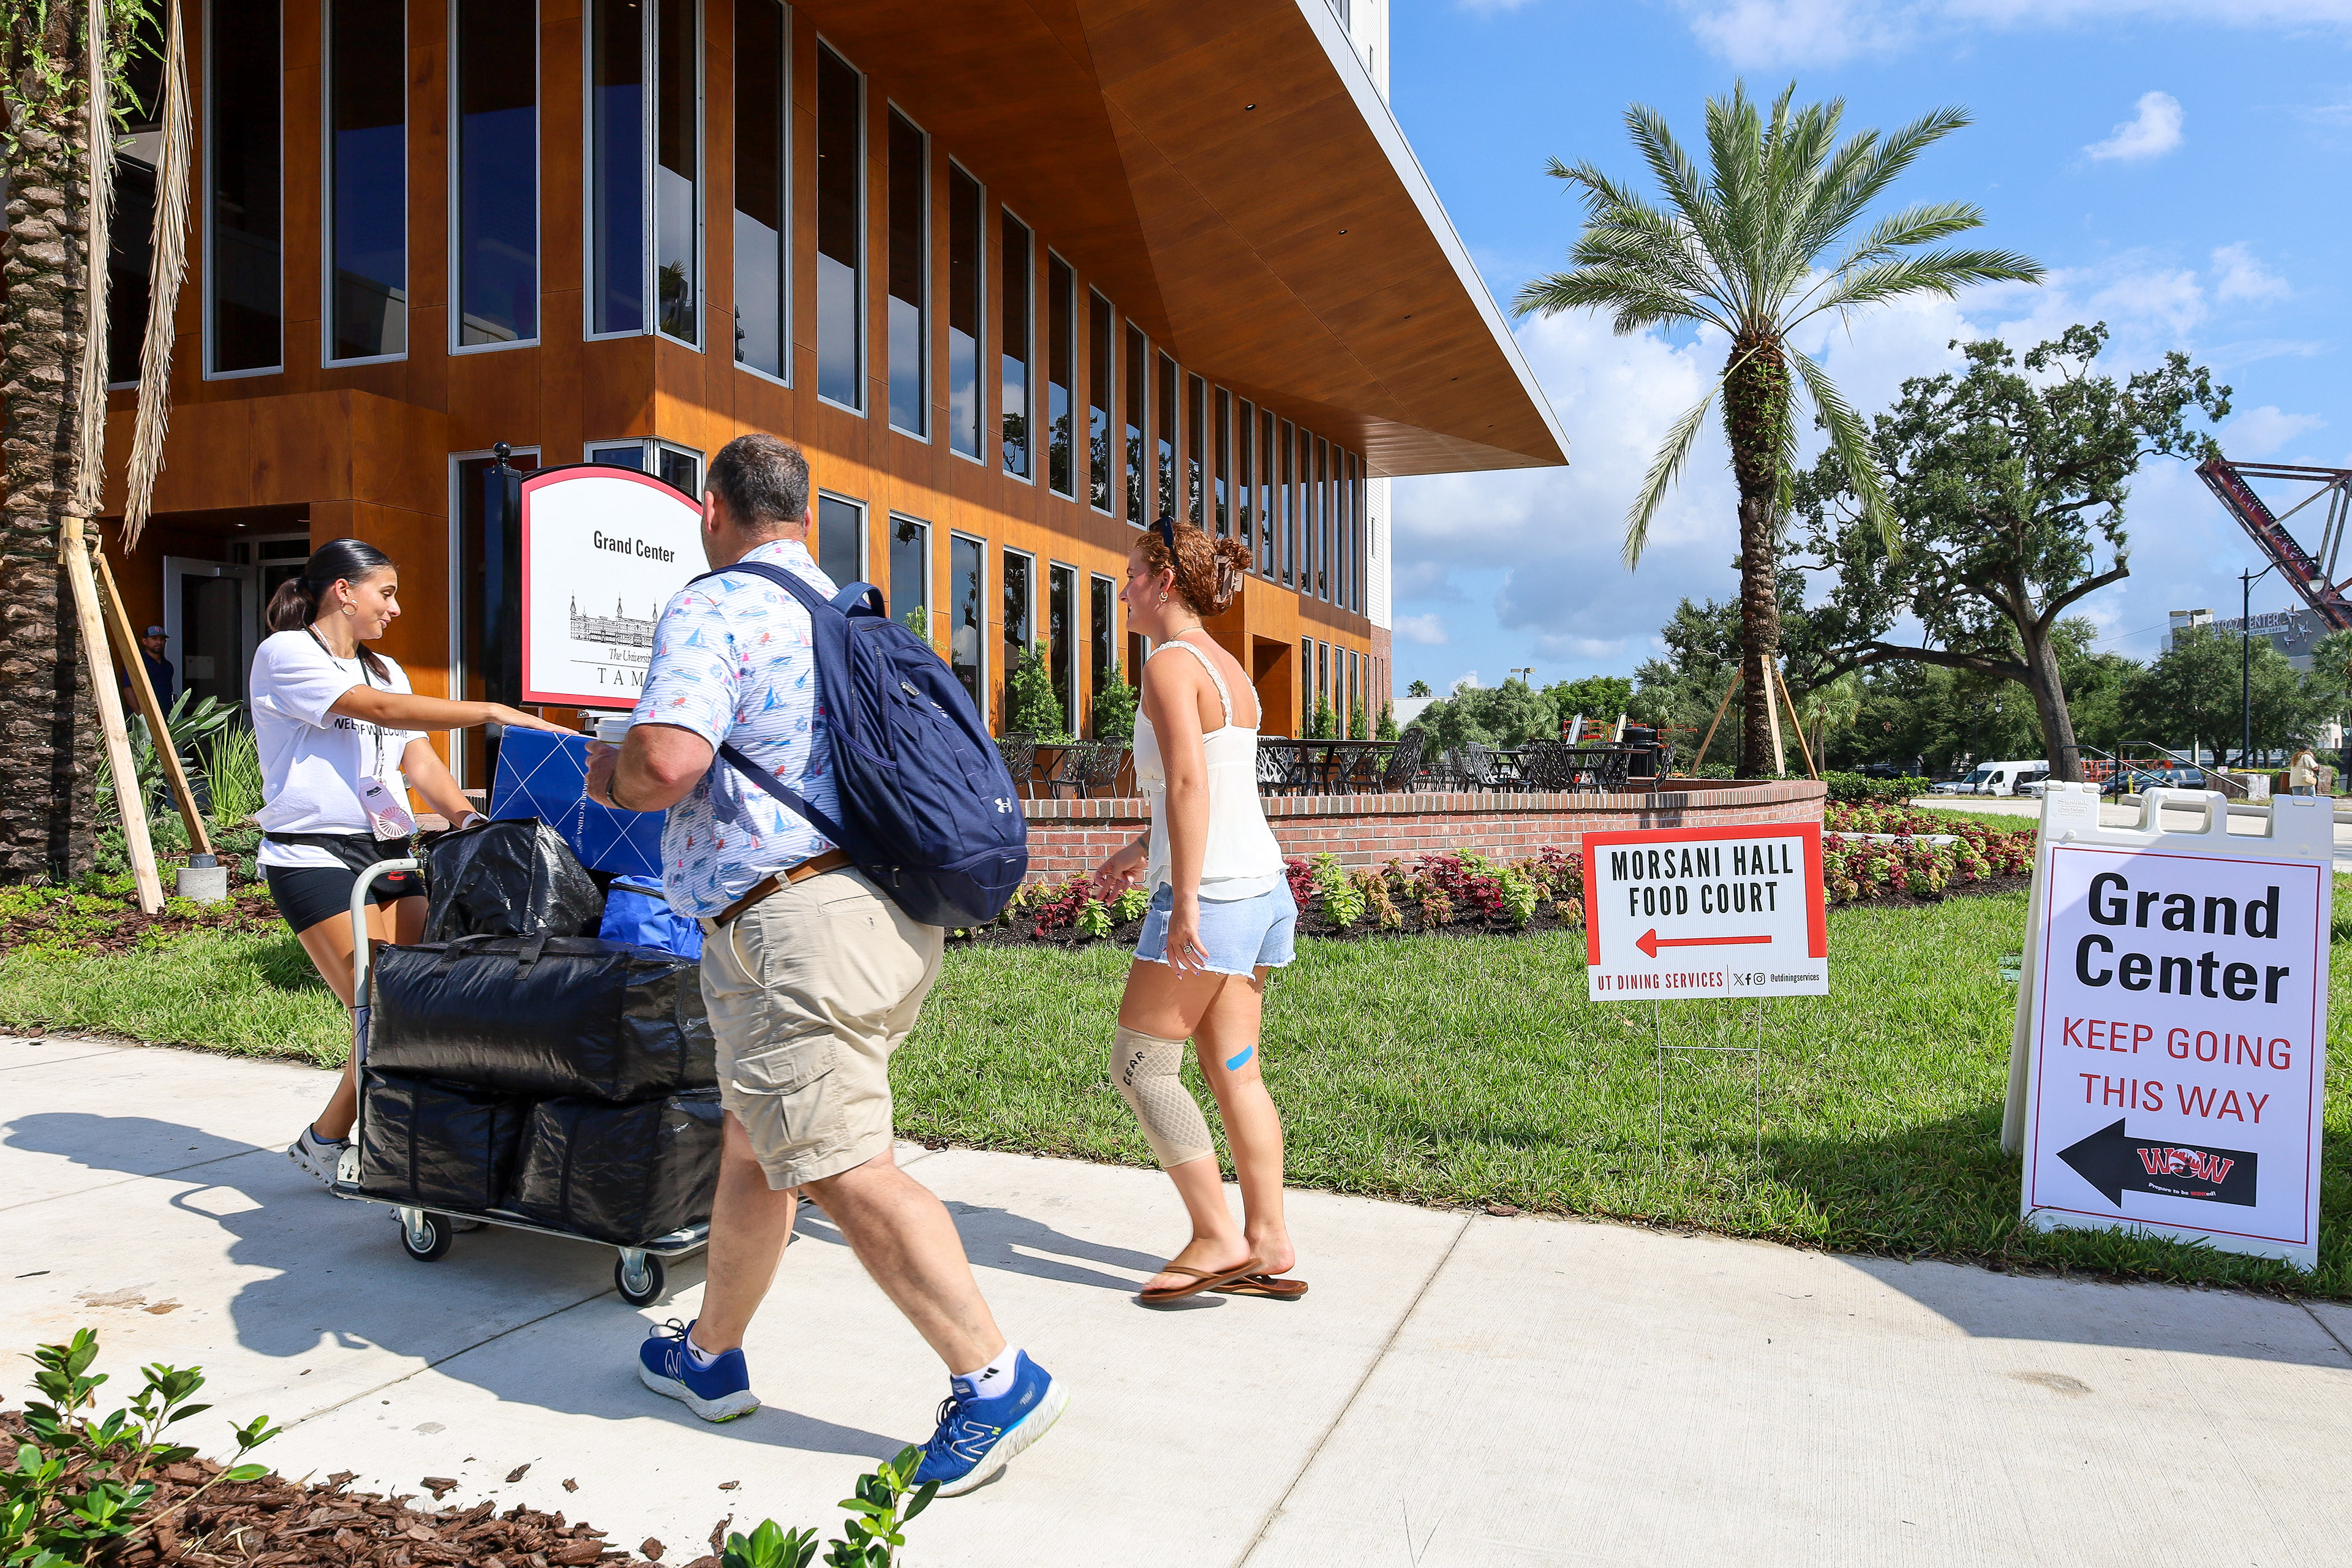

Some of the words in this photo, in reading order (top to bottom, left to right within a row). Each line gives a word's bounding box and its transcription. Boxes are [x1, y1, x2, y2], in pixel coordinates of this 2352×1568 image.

[594, 530, 631, 555] Grand
[636, 539, 675, 563] Center
[2211, 617, 2241, 633] STRAZ
[2248, 613, 2281, 629] ENTER
[609, 648, 622, 660] The
[624, 650, 652, 665] Universit
[597, 668, 644, 687] TAM
[1611, 846, 1721, 881] MORSANI
[1733, 843, 1793, 876] HALL
[1629, 886, 1688, 917] FOOD
[1701, 881, 1777, 914] COURT
[2088, 872, 2280, 939] Grand
[1598, 975, 1612, 990] UT
[1618, 974, 1659, 990] DINING
[1665, 972, 1723, 989] SERVICES
[1770, 973, 1820, 984] @utdiningservices
[2076, 934, 2290, 1003] Center
[2062, 1017, 2153, 1054] KEEP
[2167, 1028, 2291, 1070] GOING
[1123, 1051, 1145, 1086] GEAR
[2079, 1073, 2164, 1112] THIS
[2177, 1084, 2270, 1124] WAY
[2137, 1147, 2234, 1184] WOW
[2148, 1182, 2172, 1193] Prepare
